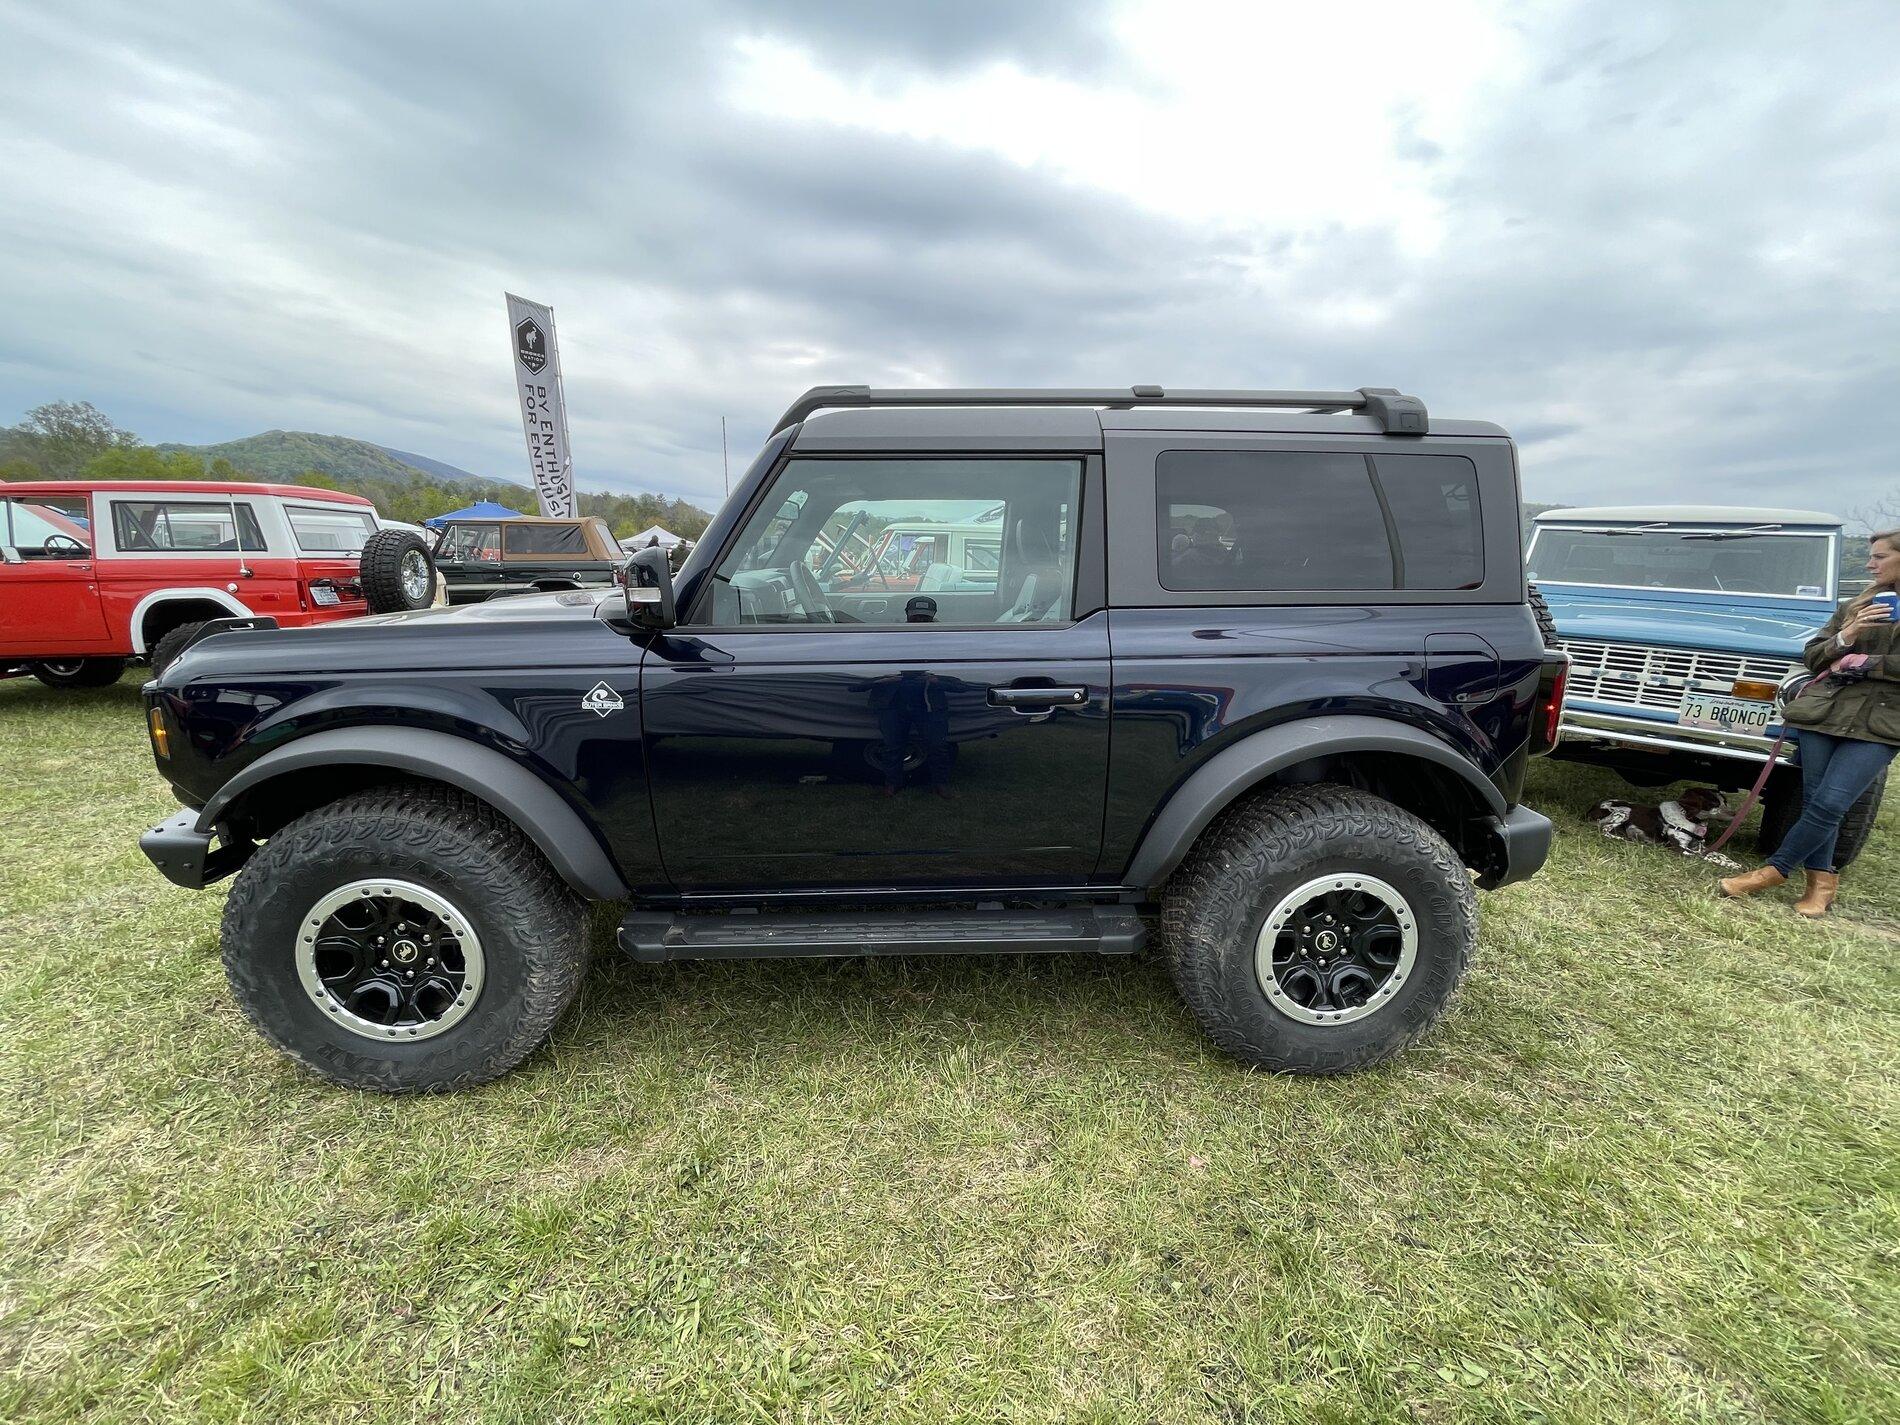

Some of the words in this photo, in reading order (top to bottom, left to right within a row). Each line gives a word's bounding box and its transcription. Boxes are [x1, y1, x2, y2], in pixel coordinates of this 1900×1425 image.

[525, 384, 537, 425] FOR
[537, 386, 550, 413] BY
[1684, 703, 1702, 718] 73
[1710, 706, 1767, 727] BRONCO
